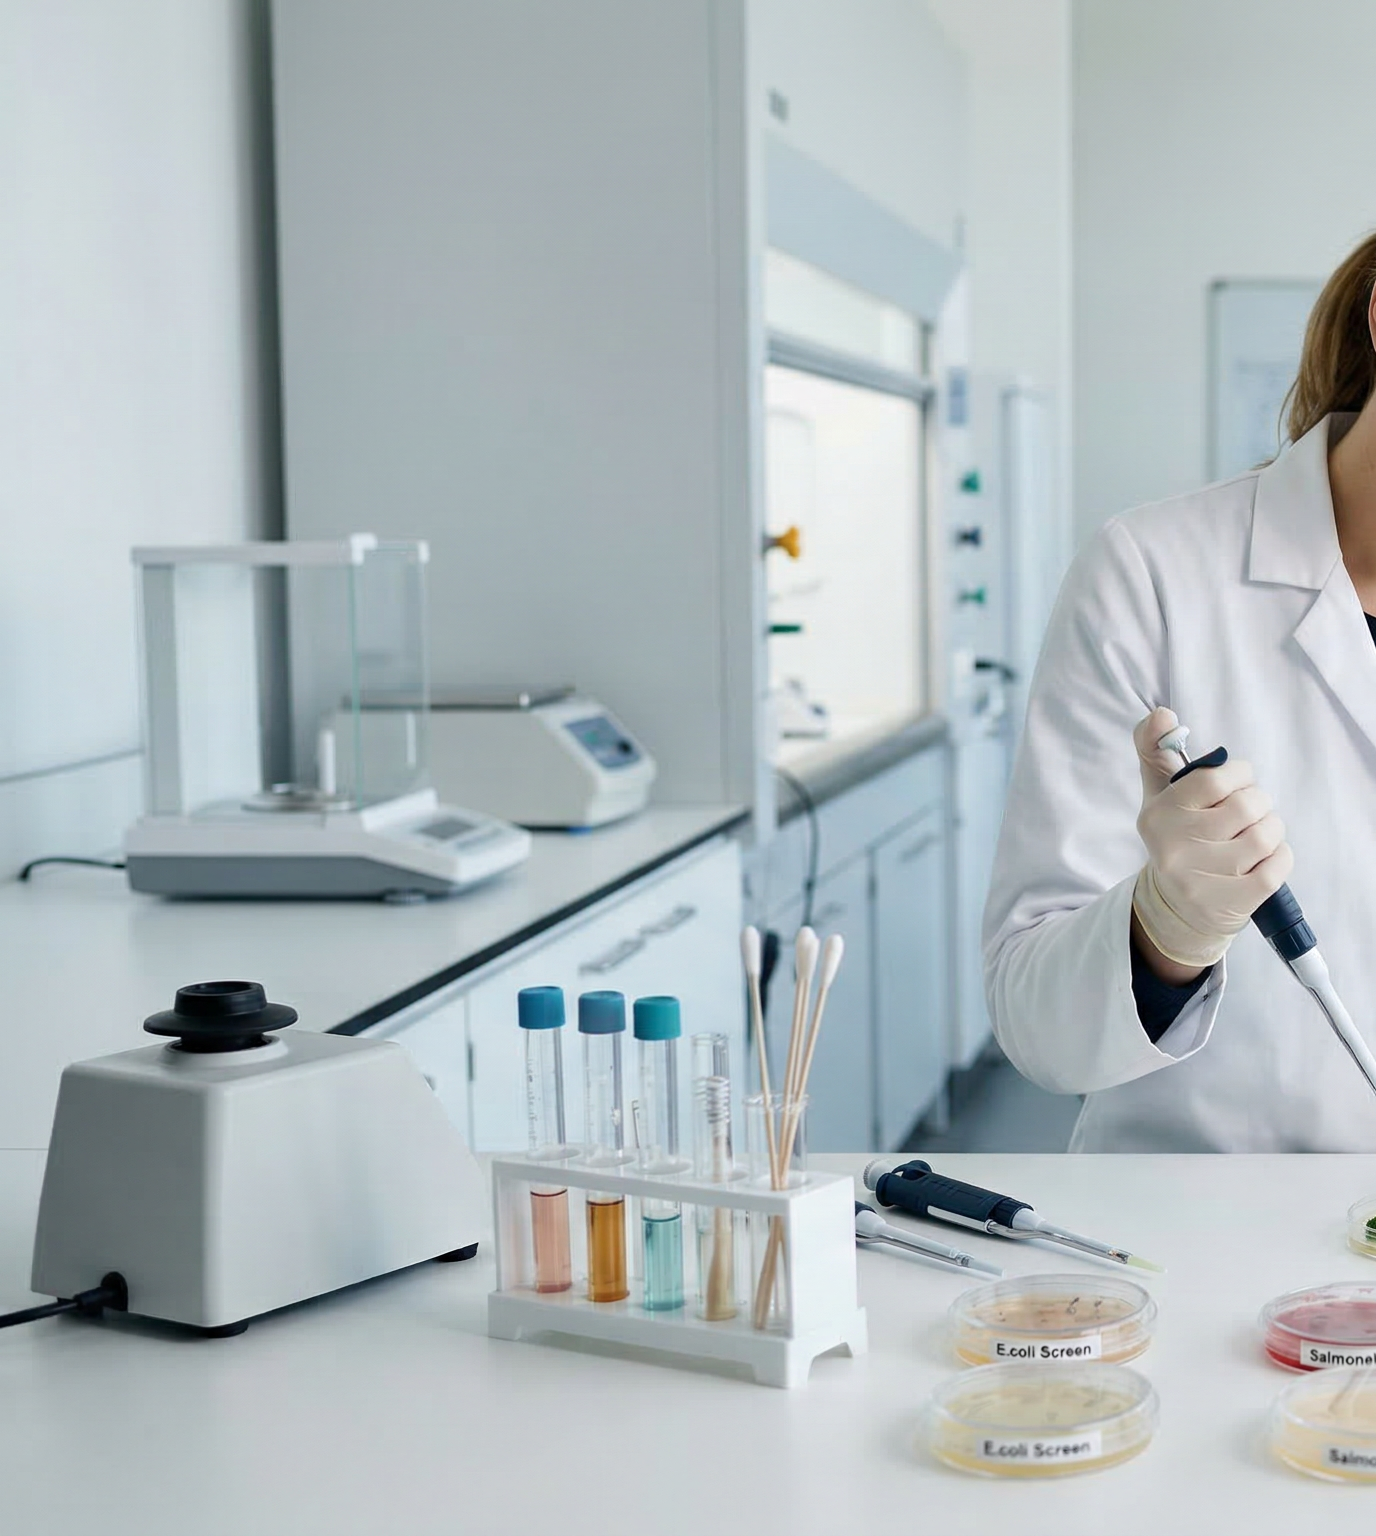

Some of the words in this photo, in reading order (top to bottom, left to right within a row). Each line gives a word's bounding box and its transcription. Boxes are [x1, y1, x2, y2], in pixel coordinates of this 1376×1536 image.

[996, 1342, 1035, 1358] E.coli
[1040, 1343, 1091, 1358] Screen
[983, 1439, 1027, 1457] E.coli
[1033, 1441, 1090, 1457] Screen
